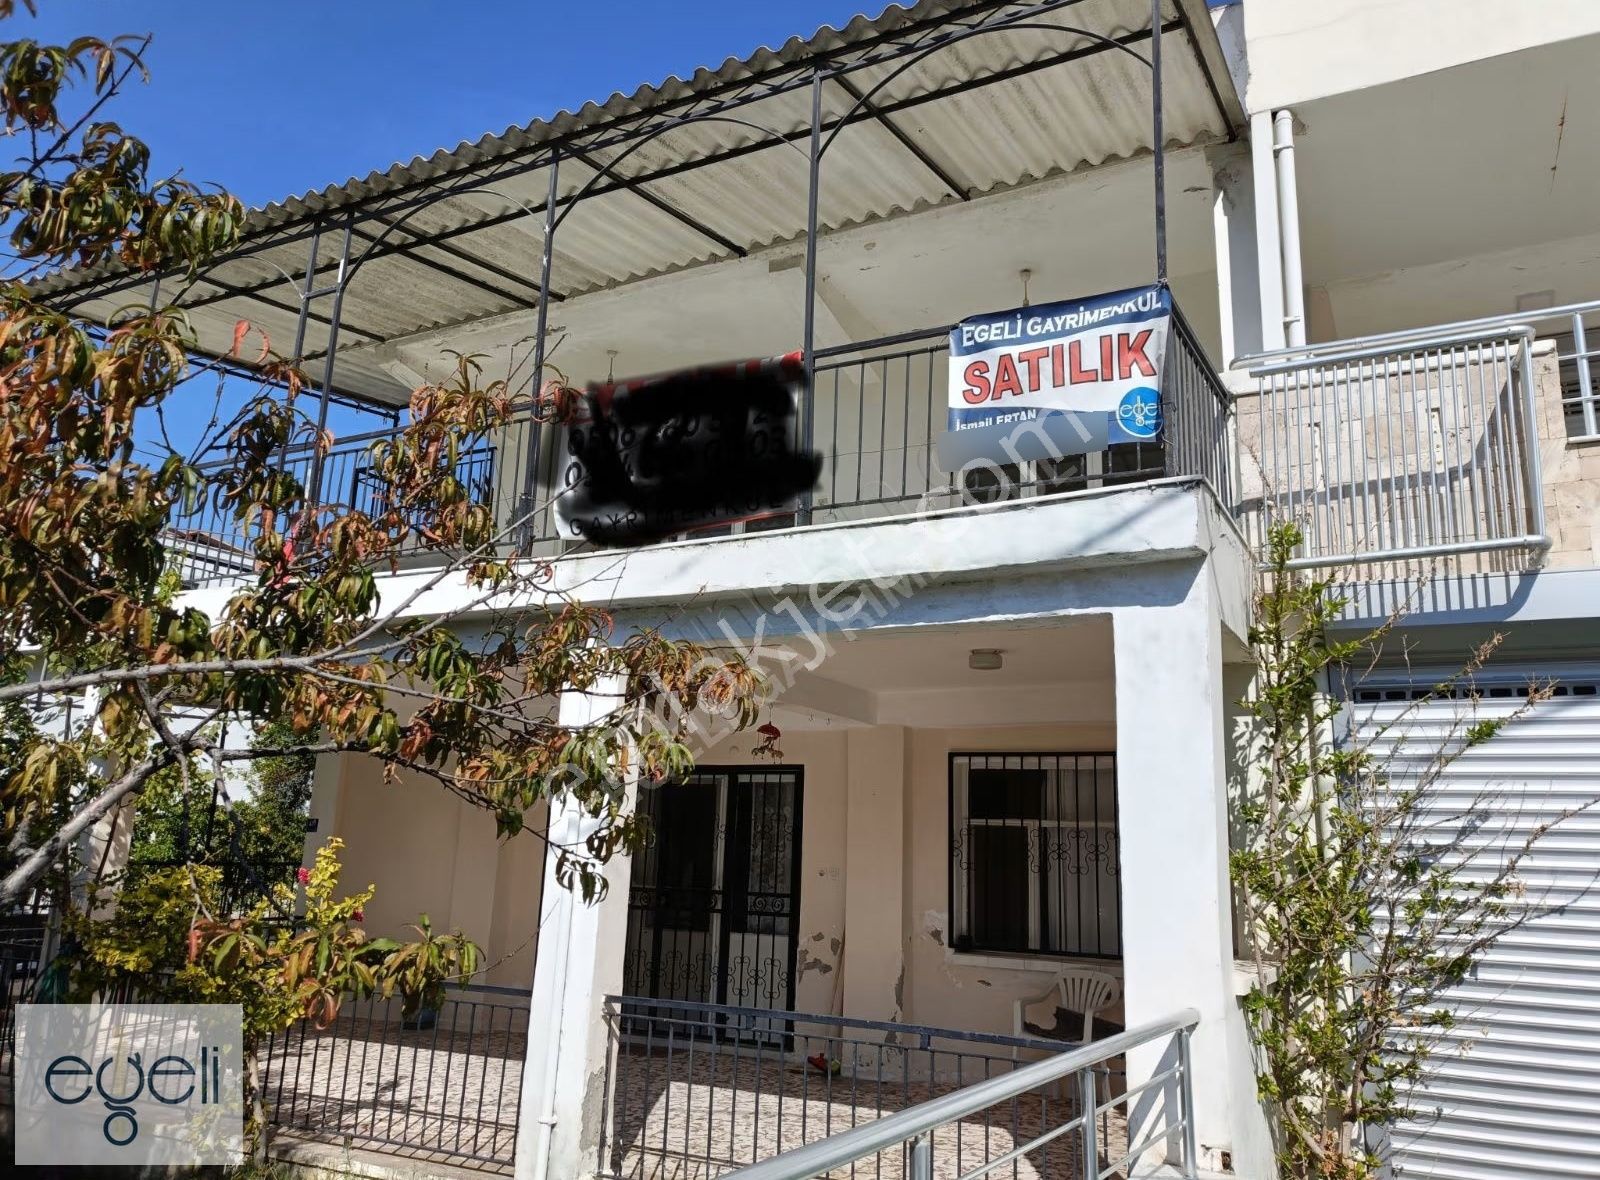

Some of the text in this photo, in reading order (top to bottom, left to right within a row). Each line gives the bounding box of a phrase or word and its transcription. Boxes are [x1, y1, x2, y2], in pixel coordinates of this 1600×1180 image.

[961, 291, 1162, 347] EGELİ GAYRİMENKUL
[962, 329, 1157, 404] SATILIK
